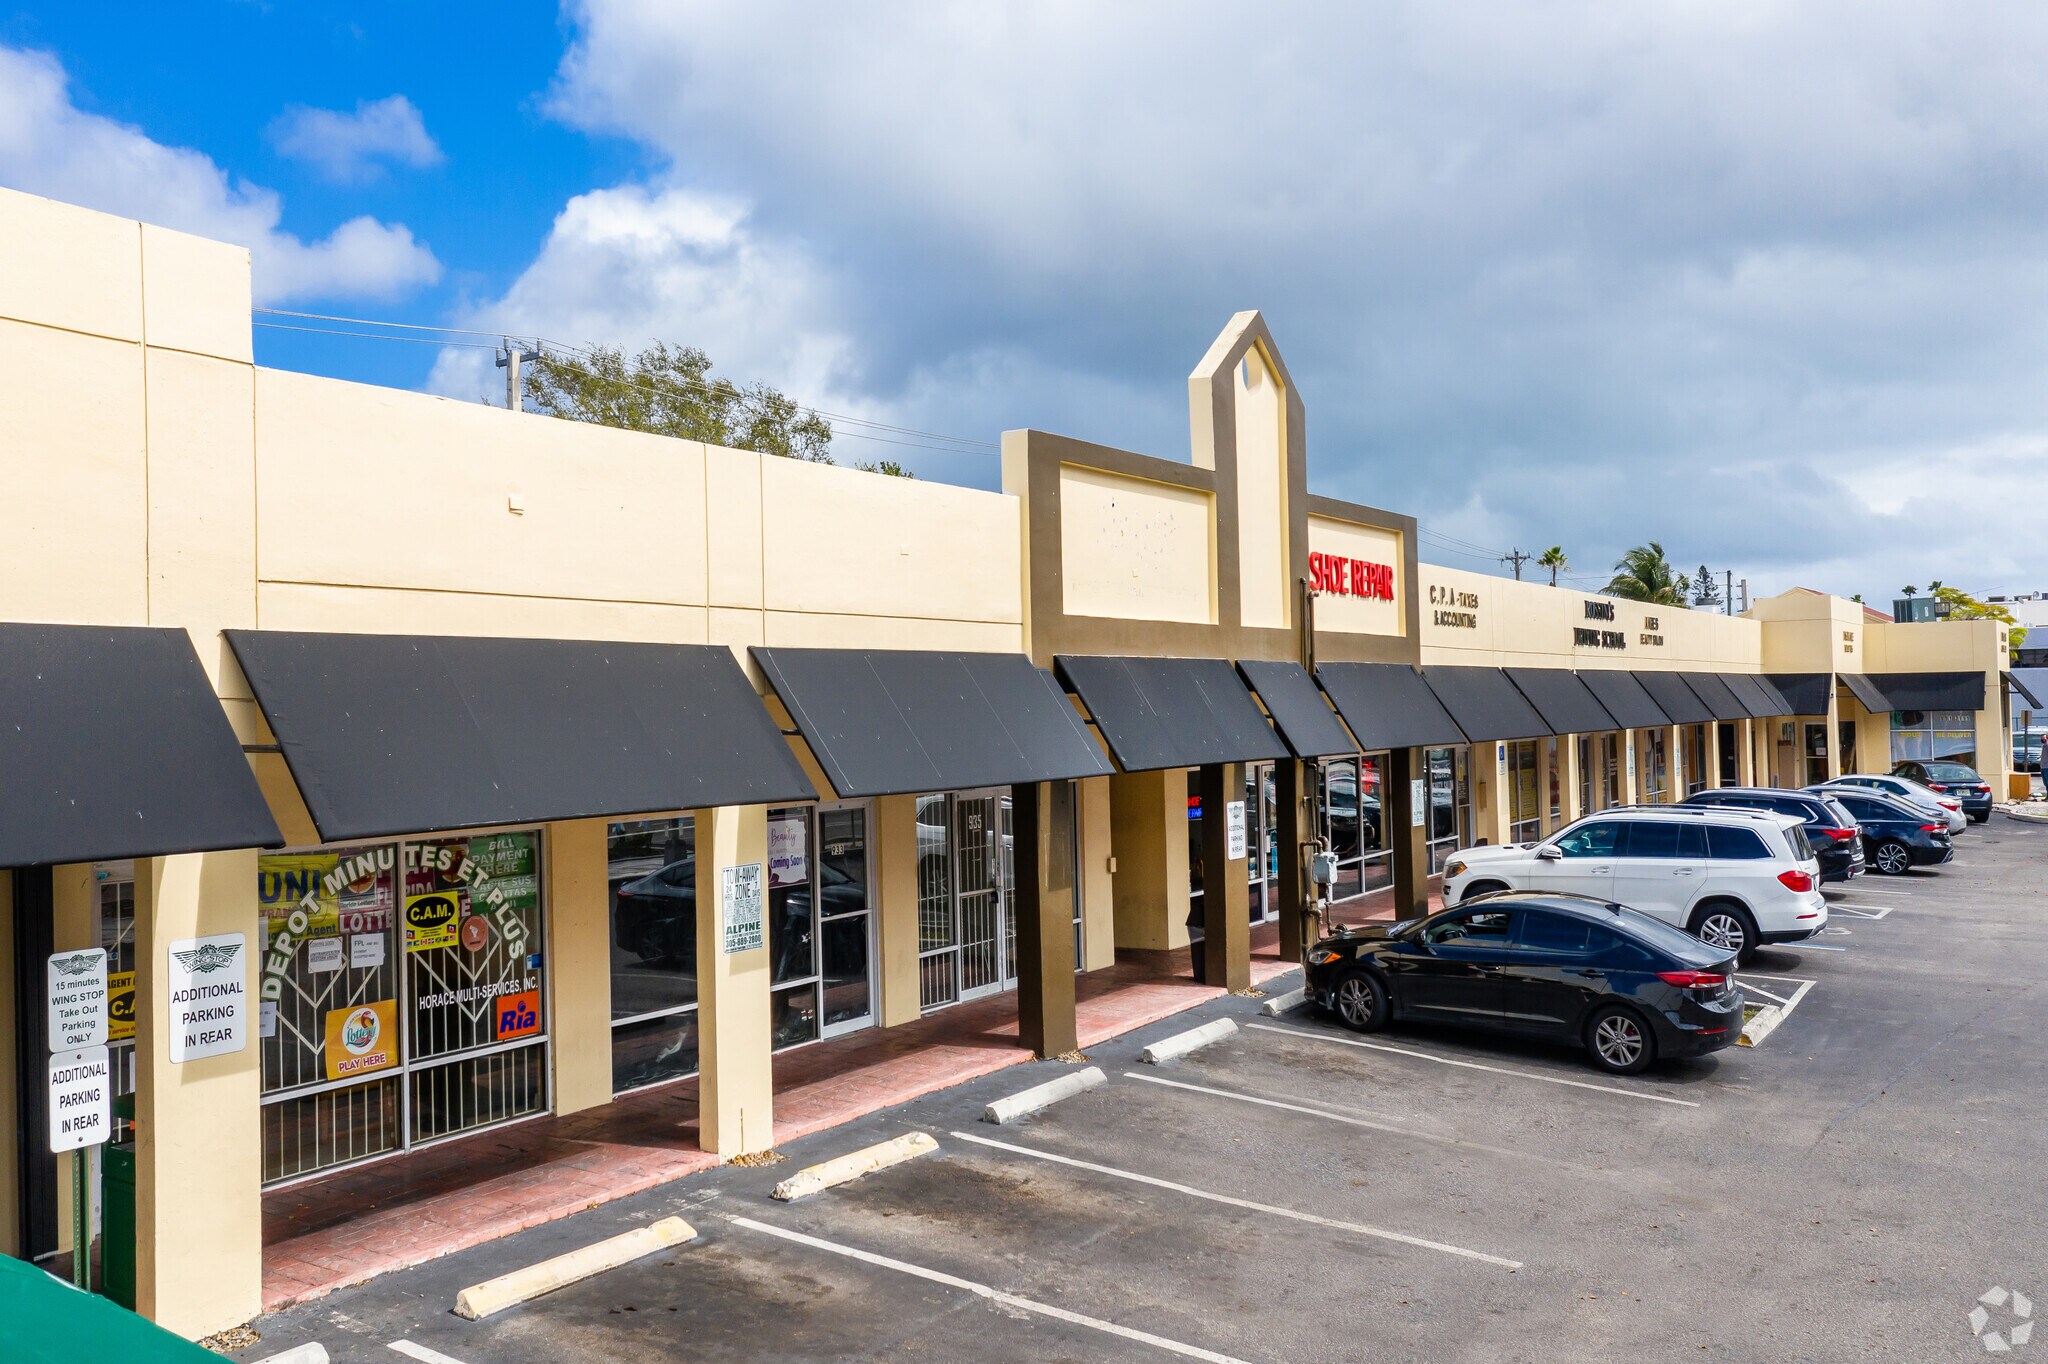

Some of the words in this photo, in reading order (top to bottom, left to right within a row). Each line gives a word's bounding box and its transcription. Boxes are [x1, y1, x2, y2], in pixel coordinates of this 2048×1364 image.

[1309, 551, 1349, 594] SHOE
[1350, 558, 1394, 601] REPAIR
[1440, 610, 1476, 629] ACCOUNTING
[968, 814, 982, 830] 935
[488, 838, 515, 851] BILL
[771, 826, 797, 847] Beauty
[472, 848, 529, 865] PAYMENT
[831, 845, 845, 856] 933
[485, 862, 519, 875] HERE
[770, 856, 790, 869] Coming
[790, 854, 803, 867] Soon
[735, 882, 751, 900] ZONE
[410, 904, 452, 921] C.A.M.
[260, 889, 320, 1000] DEPOT
[457, 857, 490, 889] ET
[486, 886, 525, 960] PLUS
[307, 924, 336, 937] Agent
[726, 921, 761, 935] ALPINE
[55, 981, 66, 991] 15
[67, 977, 100, 989] minutes
[172, 981, 243, 1004] ADDITIONAL
[419, 991, 455, 1010] HORACE
[456, 978, 522, 1003] MULTI-SERVICES,
[523, 976, 538, 991] INC.
[52, 994, 77, 1006] WING
[80, 989, 105, 1001] STOP
[59, 1008, 80, 1018] Take
[82, 1005, 98, 1014] Out
[182, 1005, 234, 1025] PARKING
[500, 1000, 536, 1033] Ria
[61, 1020, 96, 1032] Parking
[346, 1024, 377, 1046] Lottery
[66, 1032, 92, 1044] ONLY
[185, 1034, 196, 1047] IN
[200, 1027, 232, 1045] REAR
[338, 1058, 361, 1073] PLAY
[363, 1053, 386, 1067] HERE
[51, 1062, 107, 1085] ADDITIONAL
[59, 1088, 101, 1109] PARKING
[62, 1119, 71, 1133] IN
[73, 1113, 99, 1131] REAR
